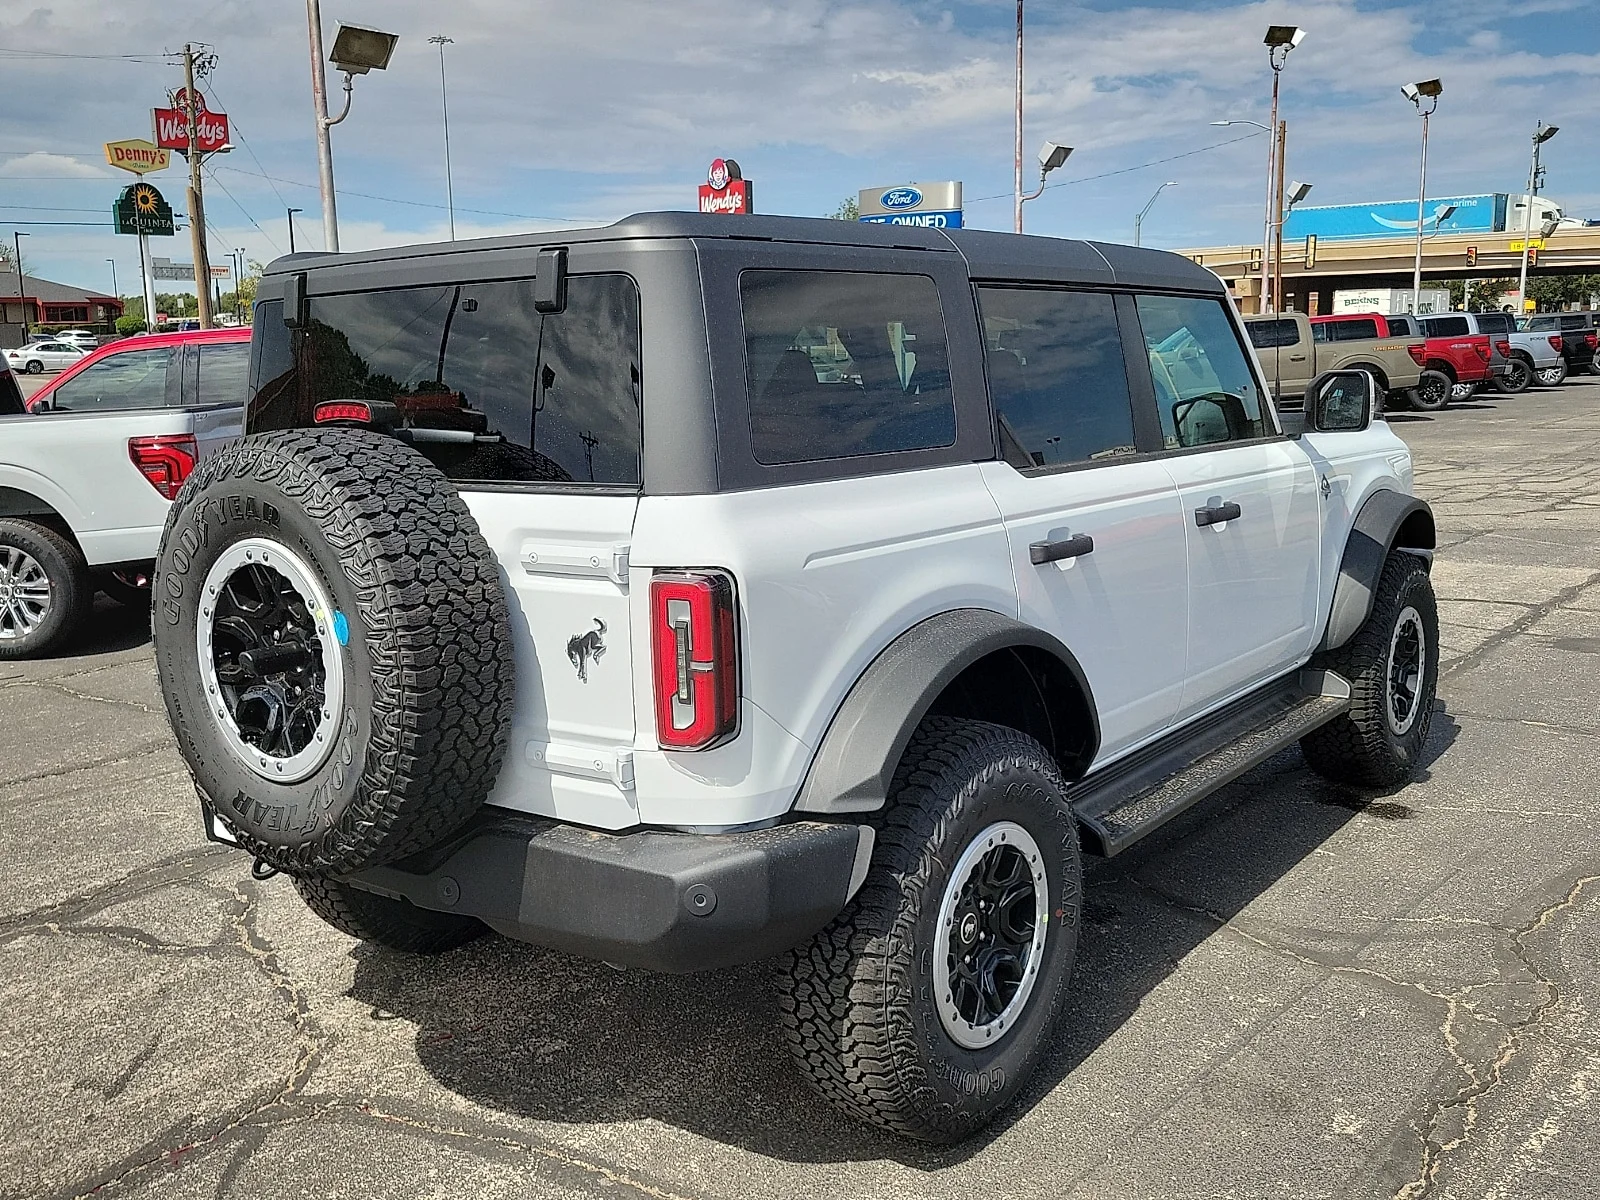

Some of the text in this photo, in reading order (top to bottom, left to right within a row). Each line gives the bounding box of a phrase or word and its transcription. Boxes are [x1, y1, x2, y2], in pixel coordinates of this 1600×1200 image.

[114, 147, 166, 165] Denny's
[701, 188, 742, 213] Wendy's
[888, 192, 912, 205] Ford
[1453, 199, 1478, 208] prime
[130, 217, 173, 228] QUINTA
[1344, 296, 1379, 306] BEKINS
[1408, 302, 1433, 315] BKINS
